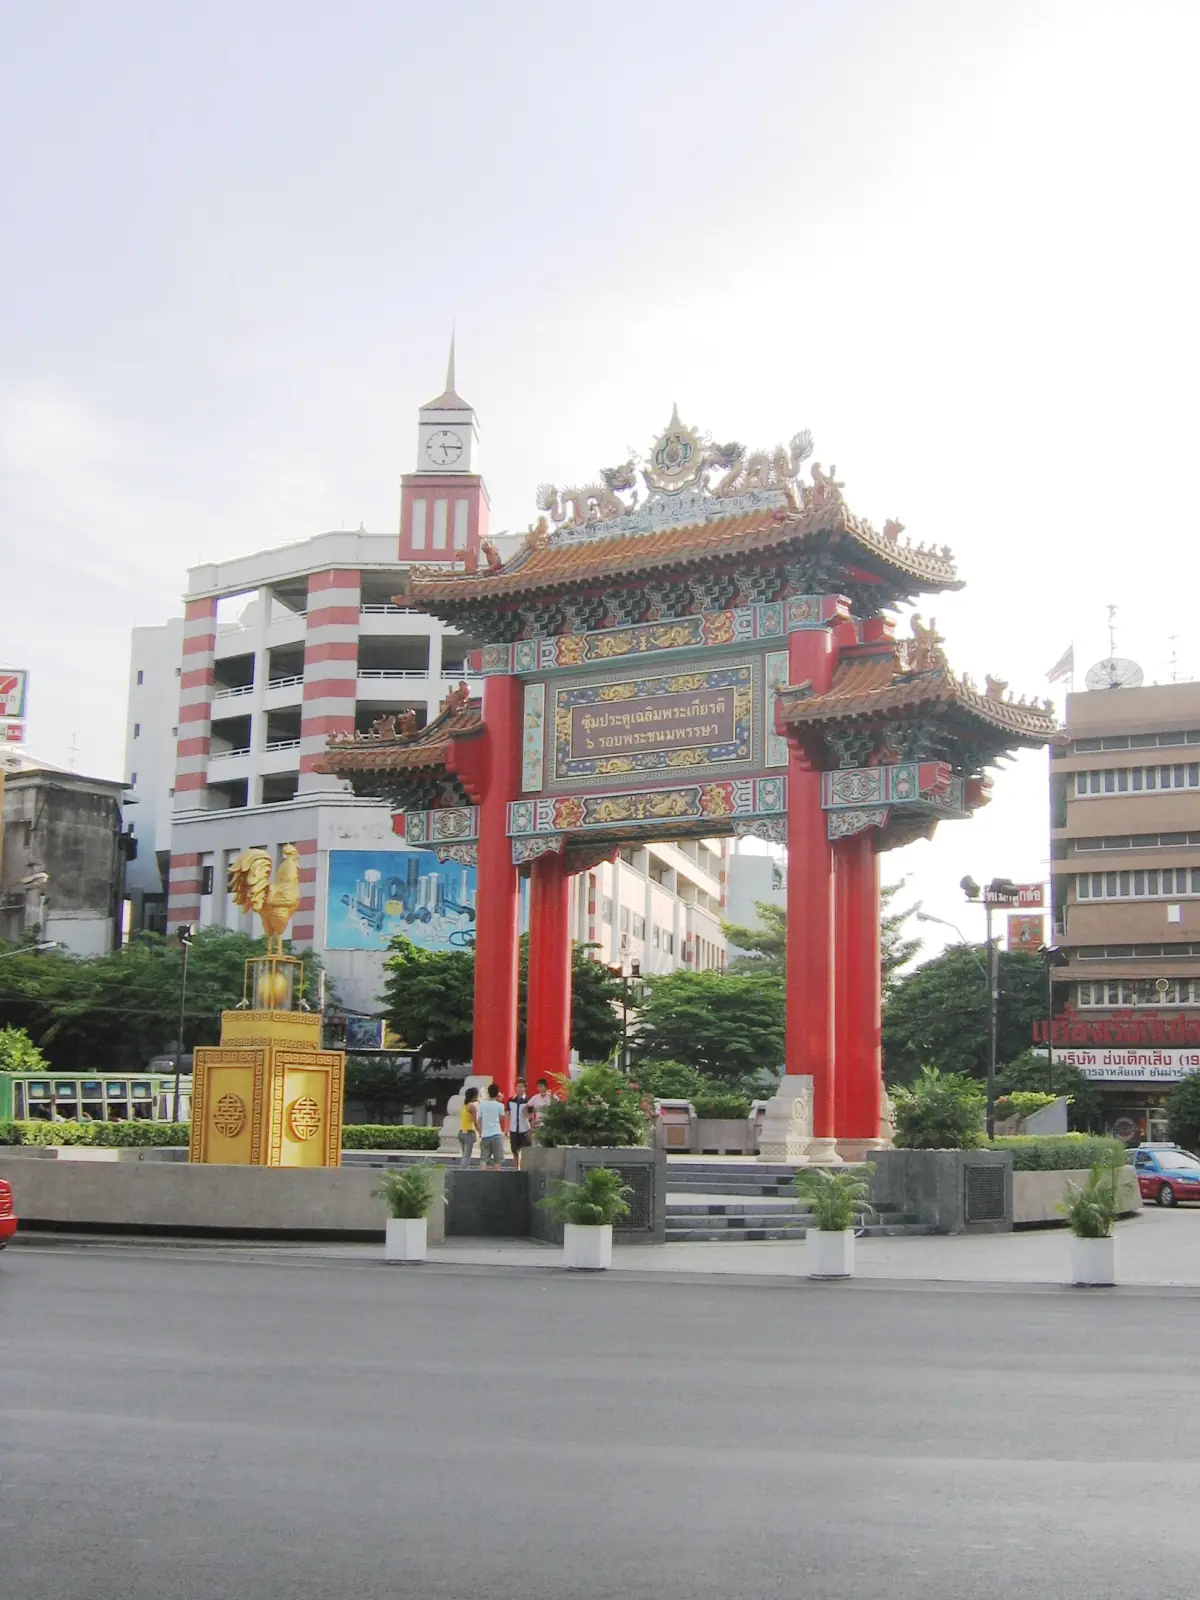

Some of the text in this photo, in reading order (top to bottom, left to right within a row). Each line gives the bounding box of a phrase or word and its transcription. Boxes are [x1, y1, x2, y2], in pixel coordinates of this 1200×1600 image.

[581, 697, 726, 733] ซุ้มประตูเฉลิมพระเกียรติ
[585, 724, 718, 749] ๖ รอบพระชนมพรรษา
